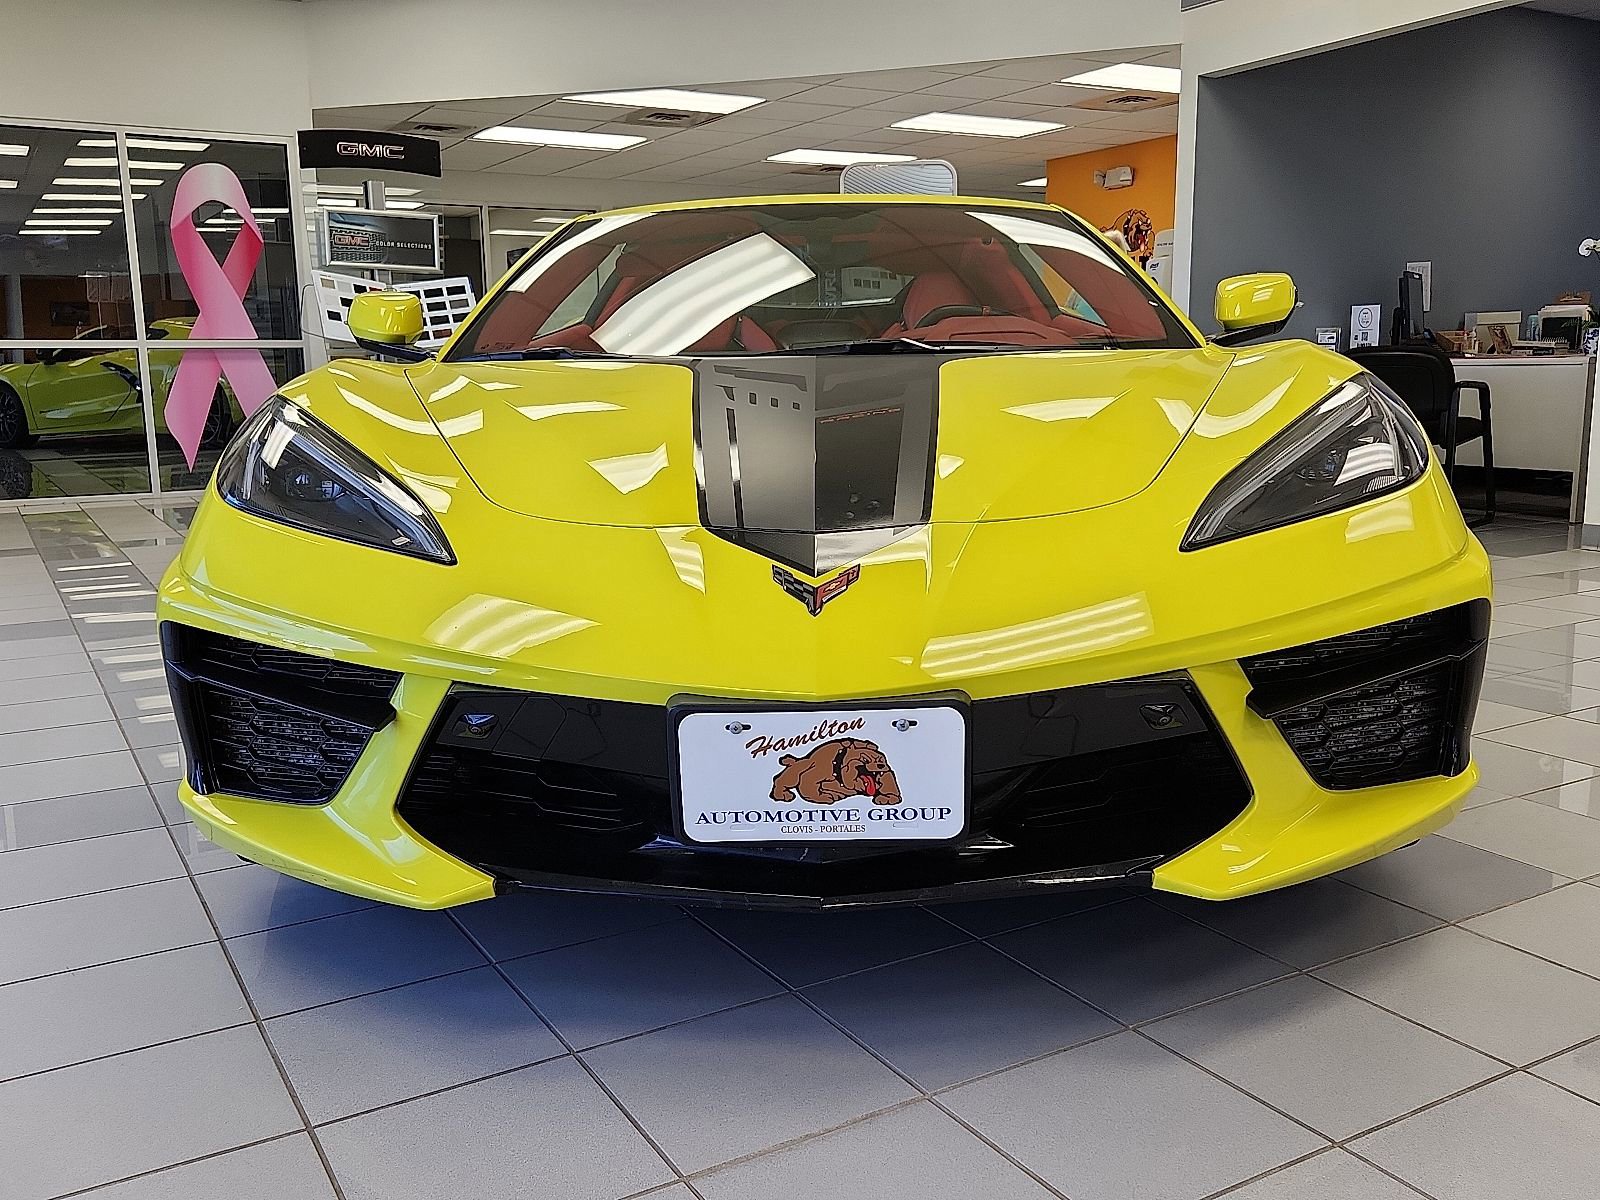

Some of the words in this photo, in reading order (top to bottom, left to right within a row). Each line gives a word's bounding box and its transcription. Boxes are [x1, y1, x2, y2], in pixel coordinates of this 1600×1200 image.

[336, 141, 405, 159] GMC
[334, 235, 369, 247] GMC
[375, 240, 395, 248] COLOR
[396, 242, 432, 250] SELECTIONS
[745, 717, 866, 759] Hamilton
[695, 808, 861, 825] AUTOMOTIVE
[867, 807, 952, 821] GROUP
[780, 825, 813, 834] CLOVIS
[820, 824, 866, 834] PORTALES
